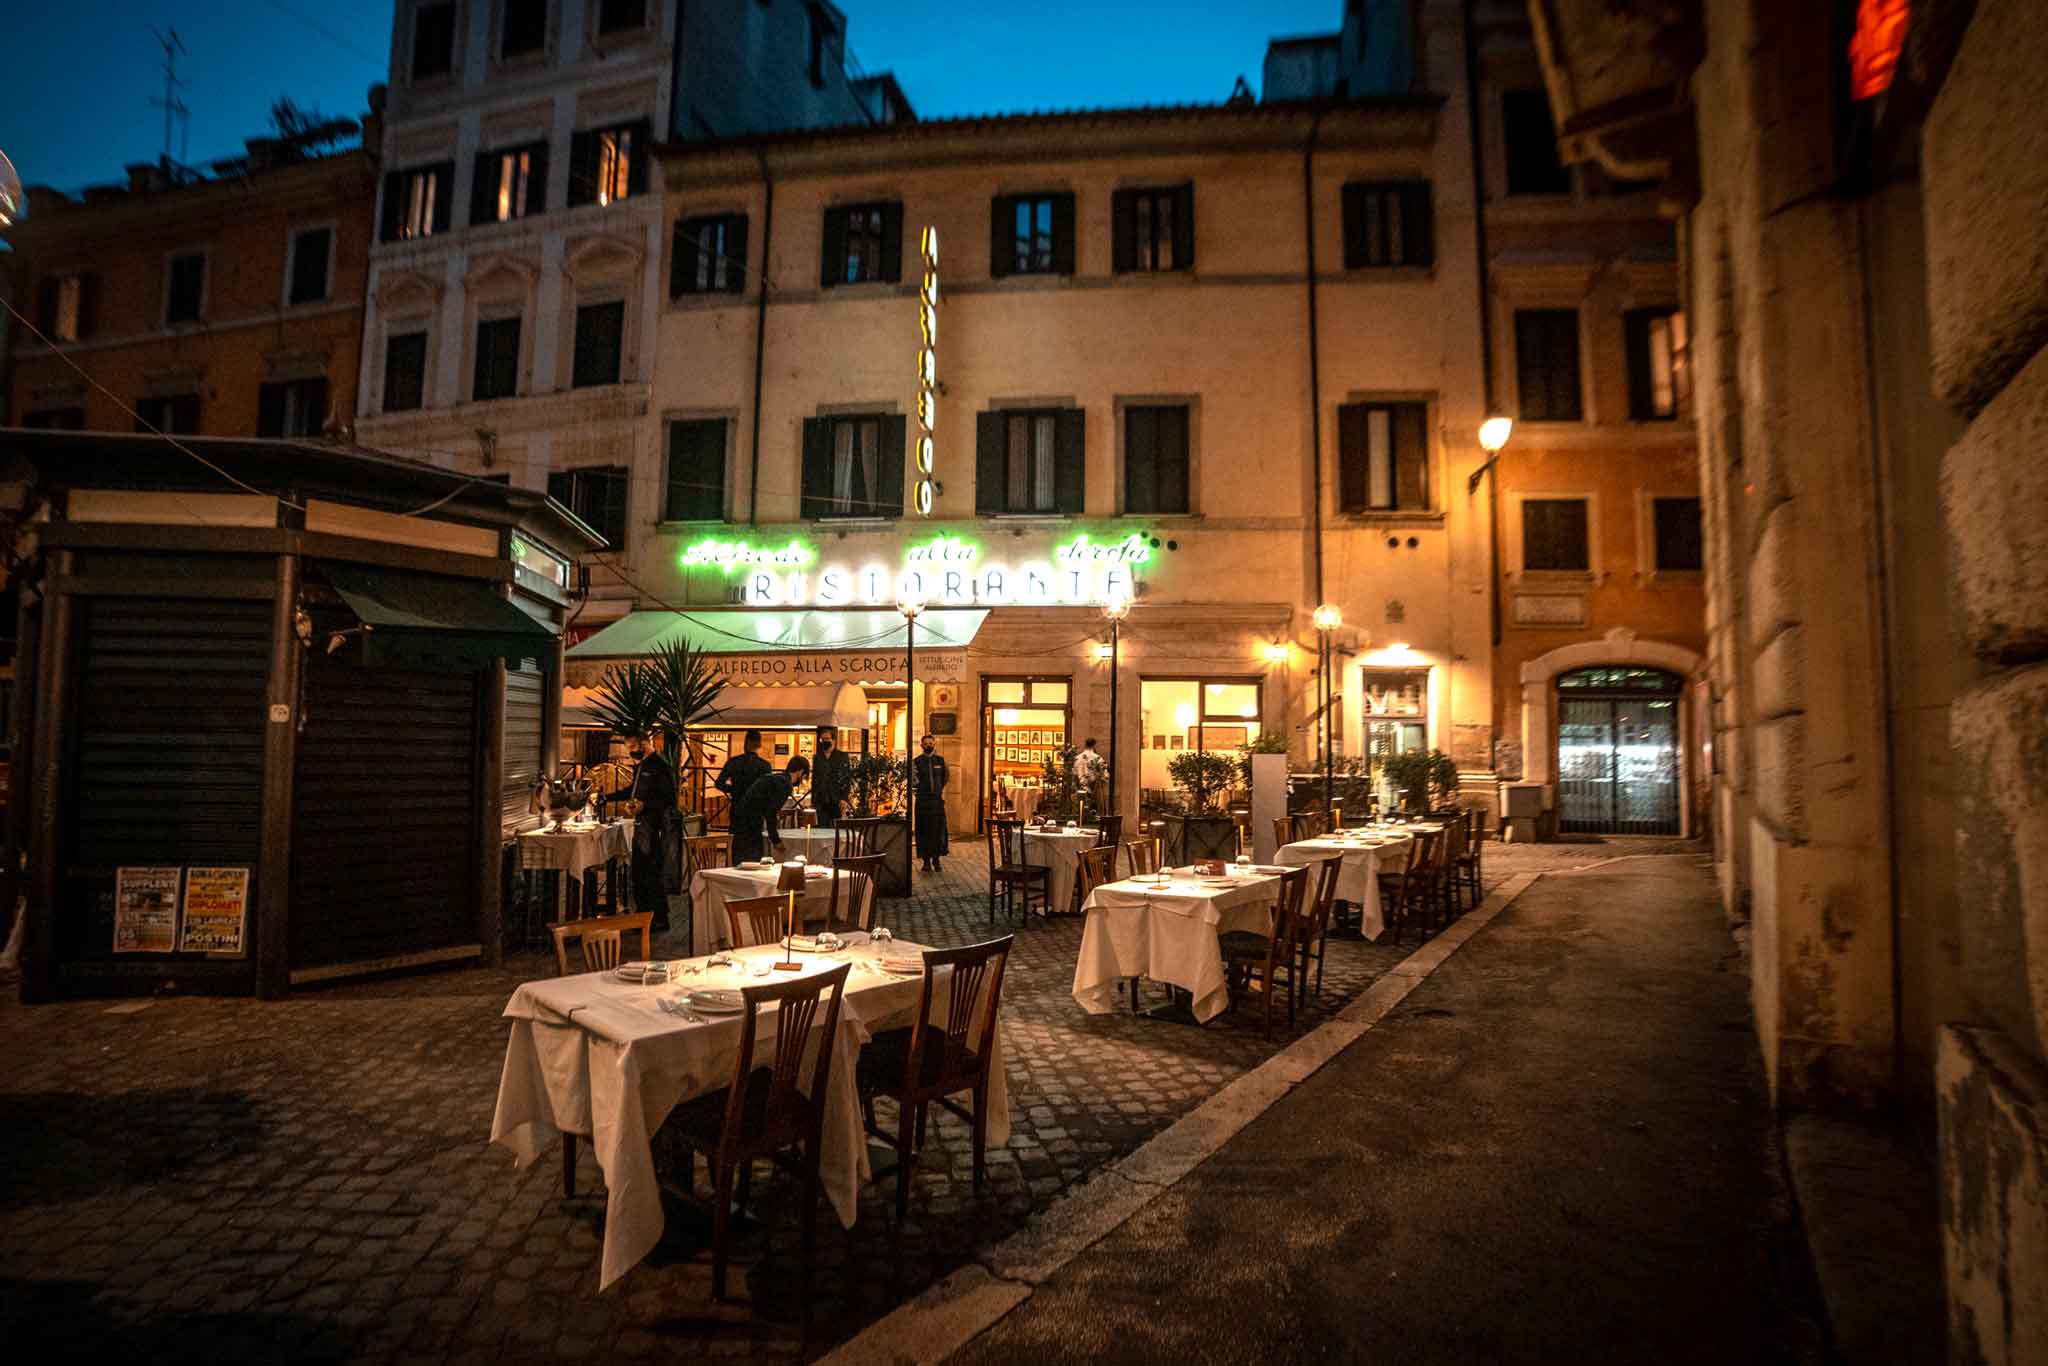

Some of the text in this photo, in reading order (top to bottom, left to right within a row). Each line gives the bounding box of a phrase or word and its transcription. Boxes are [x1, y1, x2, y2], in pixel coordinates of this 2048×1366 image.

[753, 569, 1124, 601] RISTORANTE
[714, 660, 786, 675] ALFREDO
[793, 658, 833, 673] ALLA
[839, 657, 910, 673] SCROFA
